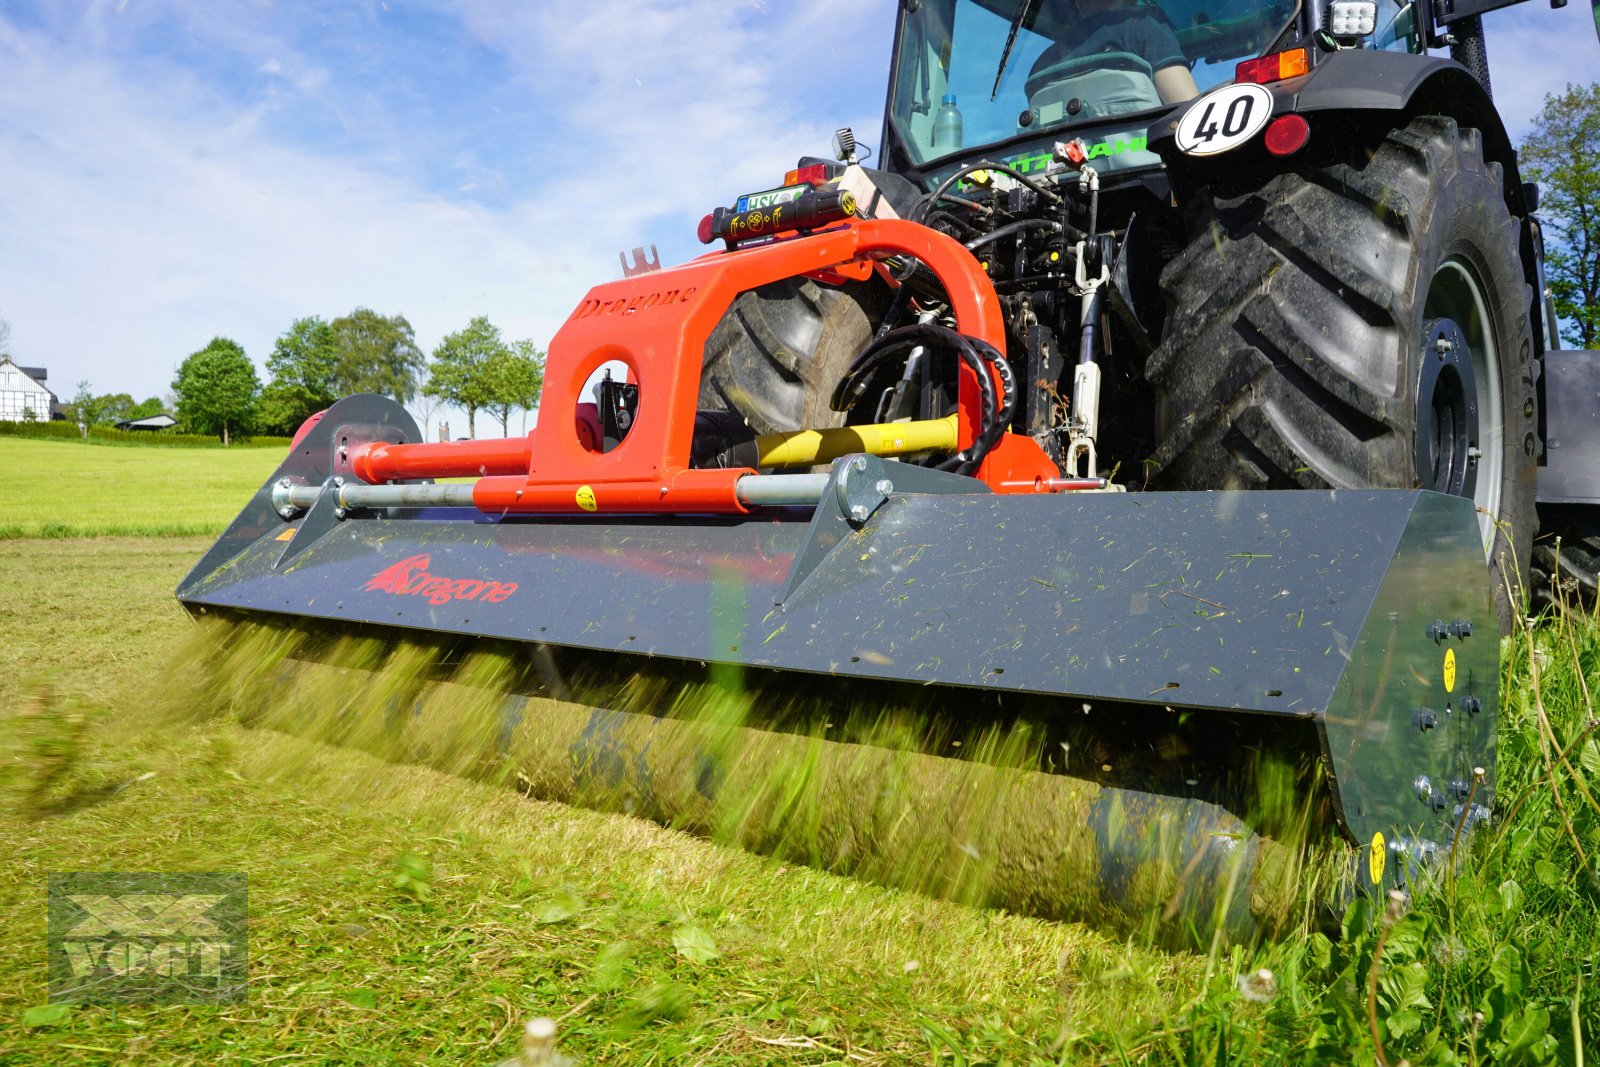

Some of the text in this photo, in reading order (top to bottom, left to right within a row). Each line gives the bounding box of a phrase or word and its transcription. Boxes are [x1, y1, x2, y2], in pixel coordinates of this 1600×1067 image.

[1193, 95, 1254, 142] 40
[749, 193, 779, 211] HSK
[573, 286, 697, 320] Dragone
